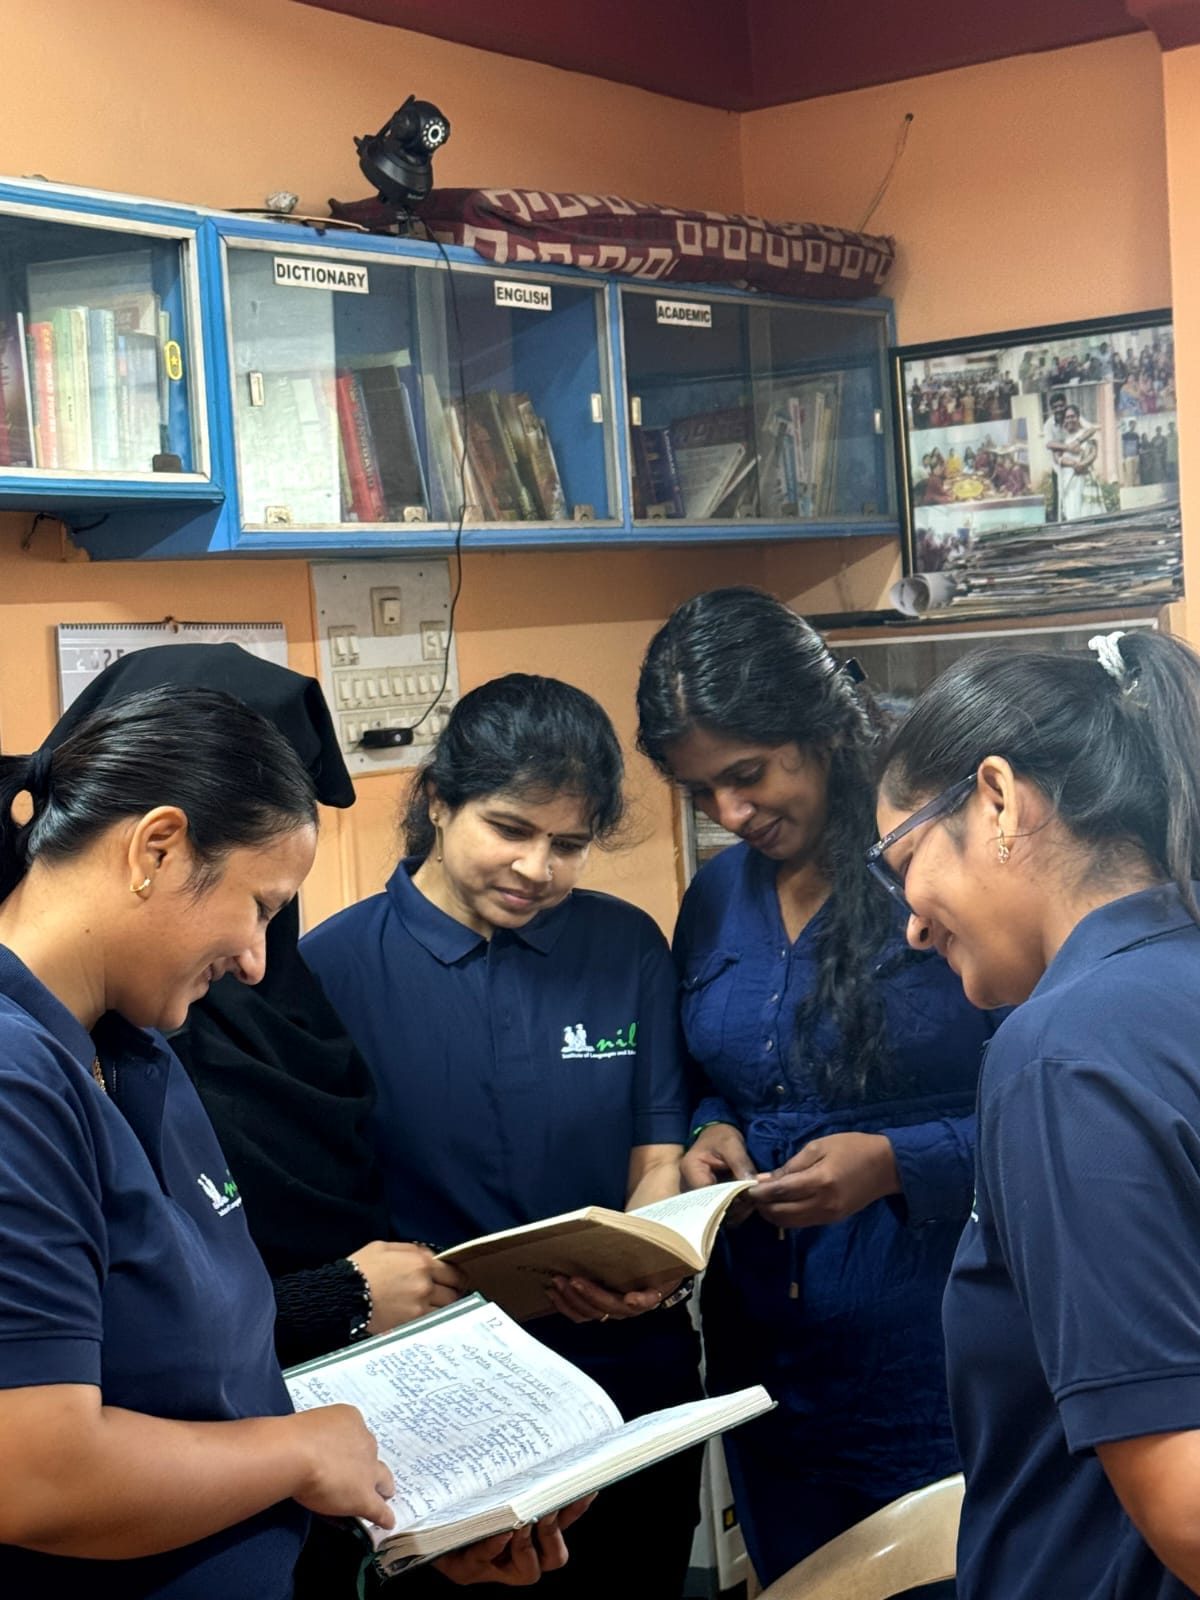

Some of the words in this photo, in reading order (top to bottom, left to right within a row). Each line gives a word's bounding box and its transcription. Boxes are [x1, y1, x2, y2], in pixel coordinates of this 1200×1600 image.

[276, 263, 366, 288] DICTIONARY
[496, 286, 550, 306] ENGLISH
[658, 305, 710, 323] ACADEMIC
